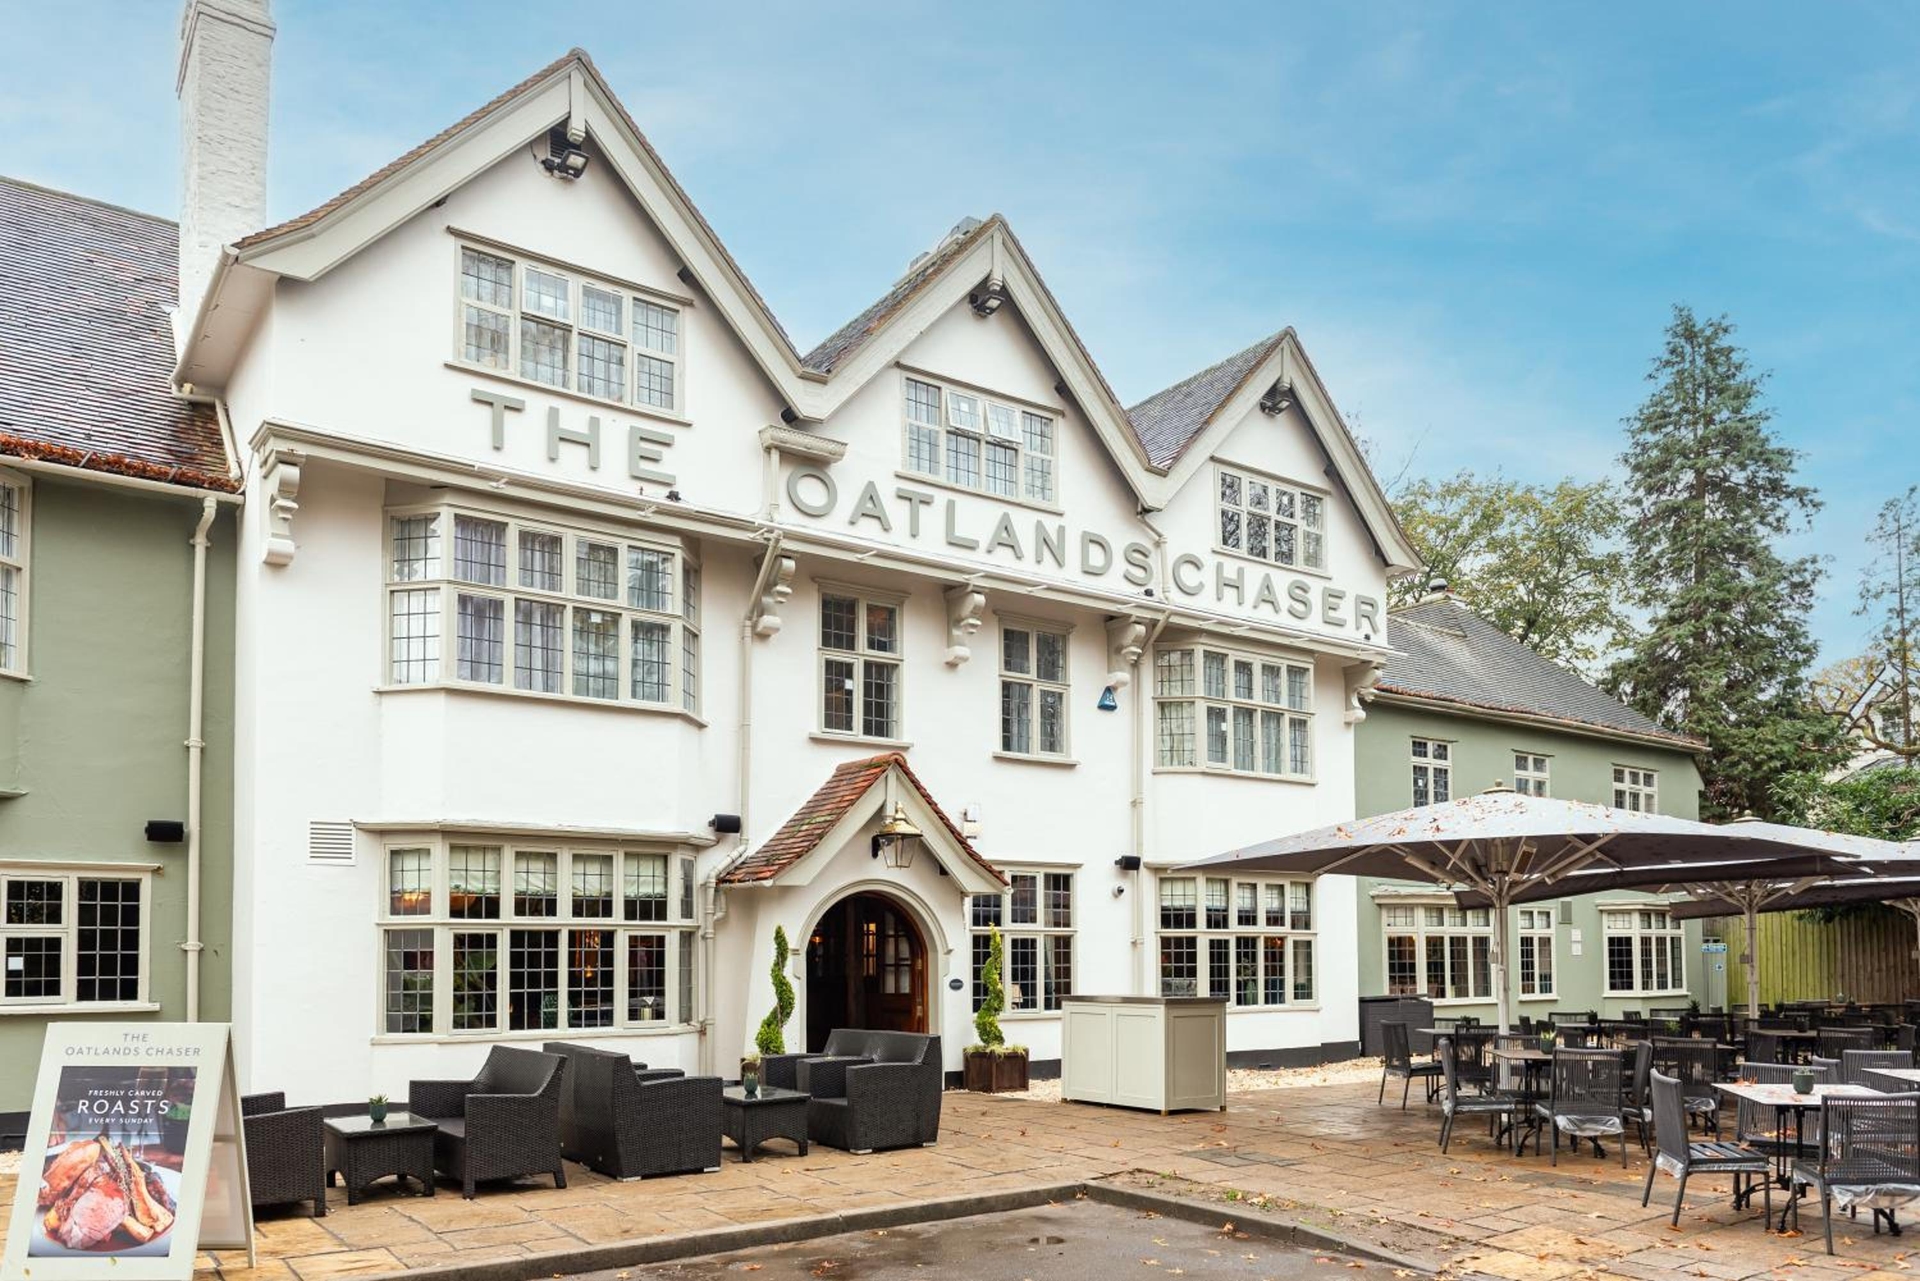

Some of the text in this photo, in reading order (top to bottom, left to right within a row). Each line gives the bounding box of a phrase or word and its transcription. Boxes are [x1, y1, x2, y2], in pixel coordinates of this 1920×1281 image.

[471, 388, 1381, 634] THE OATLANDS CHASER
[122, 1033, 149, 1043] THE
[65, 1046, 201, 1057] OATLANDS CHASER
[87, 1089, 163, 1097] FRESHLY CARVED
[77, 1099, 170, 1115] ROASTS
[88, 1117, 154, 1125] EVERY SUNDAY
